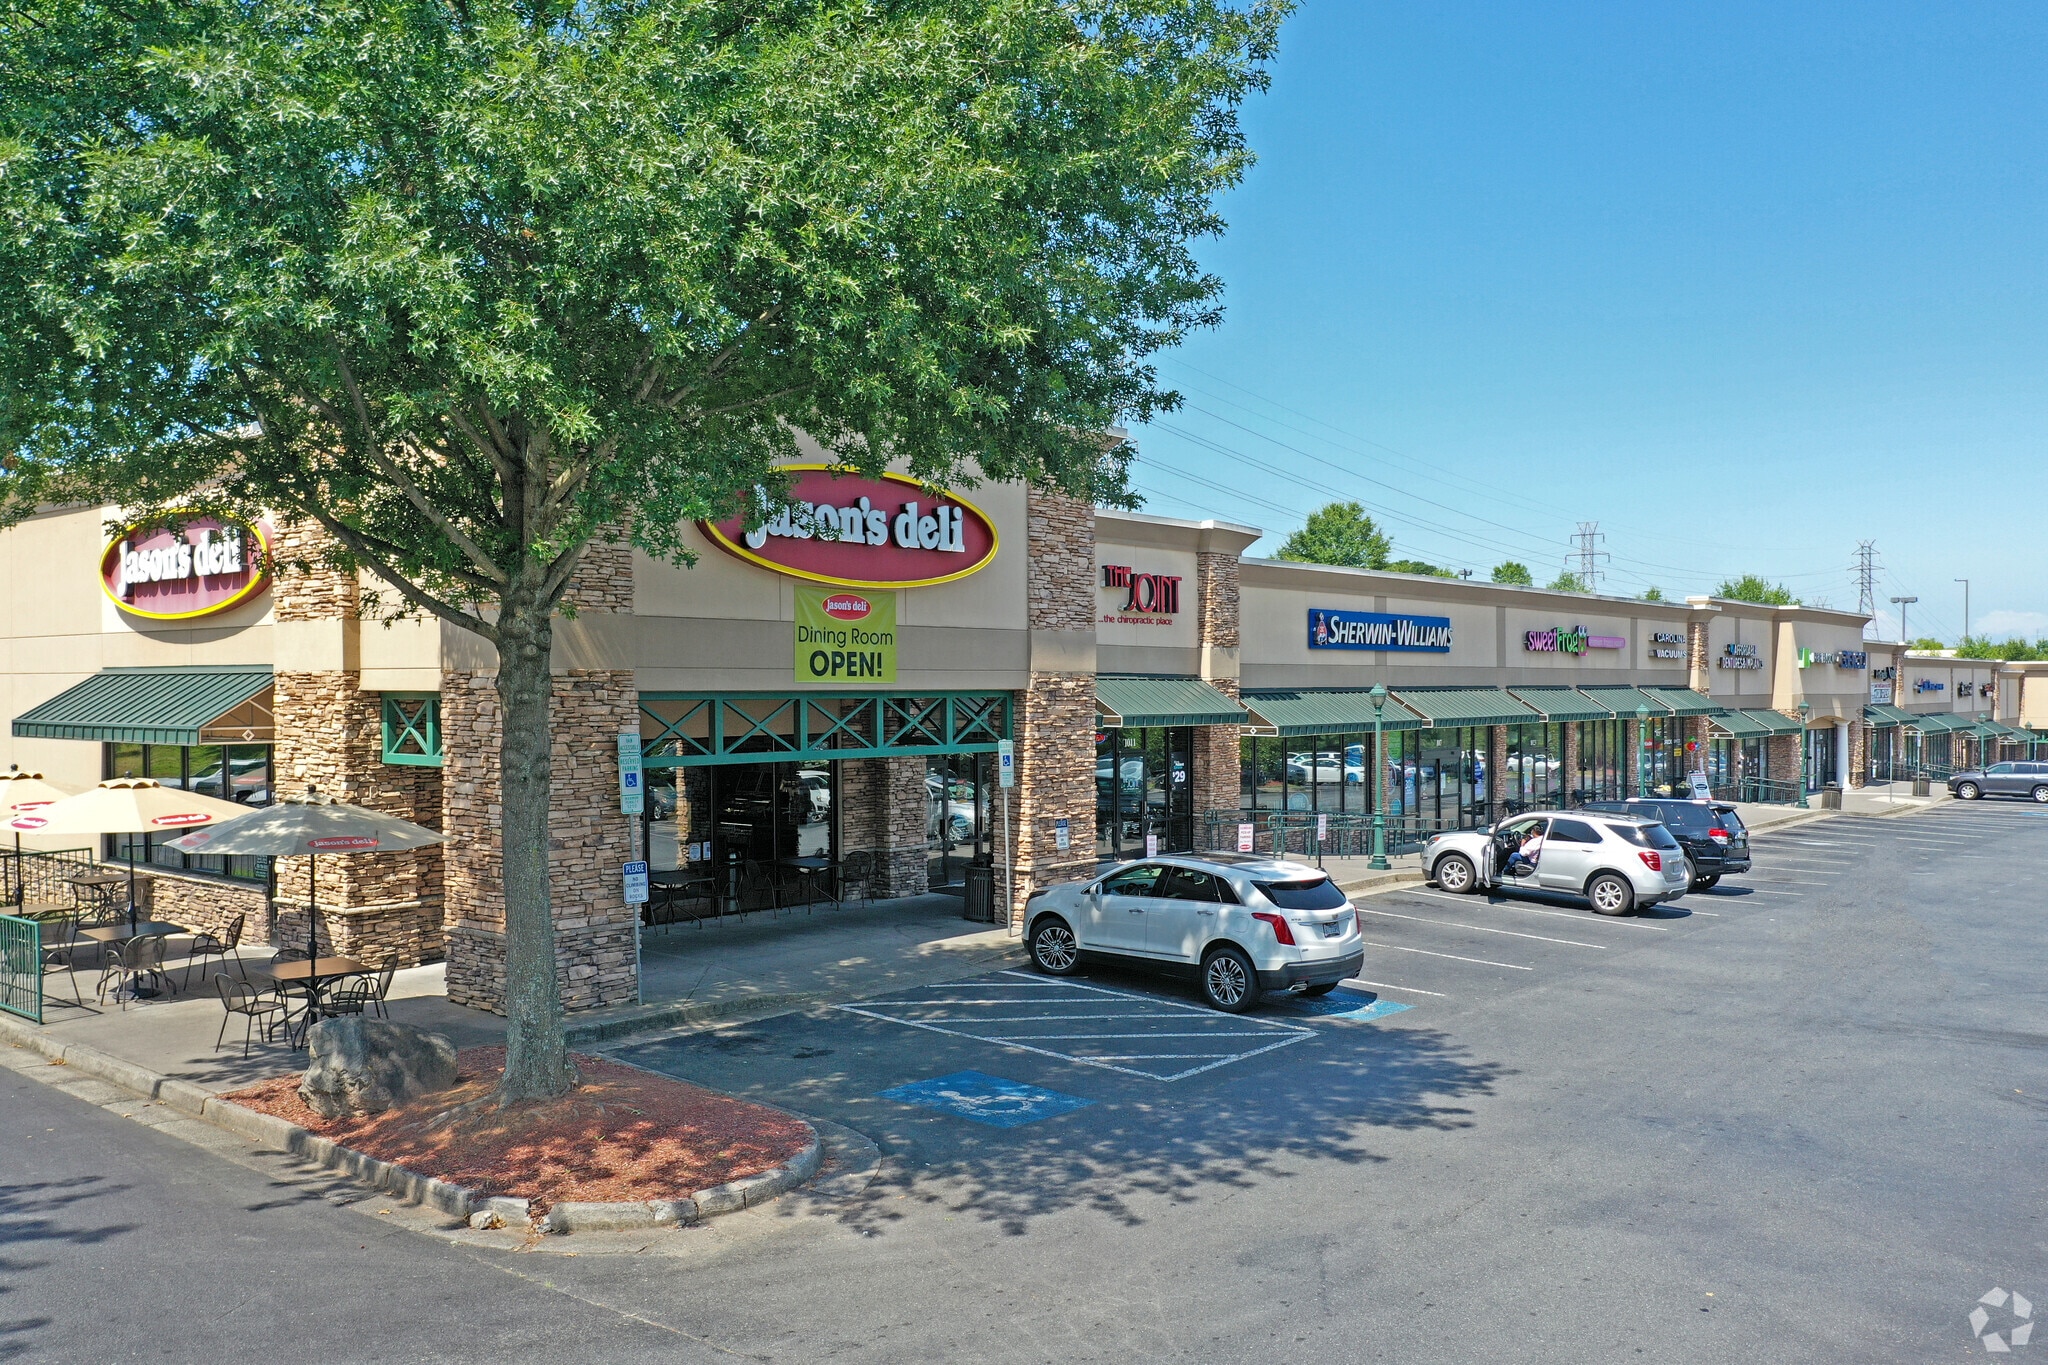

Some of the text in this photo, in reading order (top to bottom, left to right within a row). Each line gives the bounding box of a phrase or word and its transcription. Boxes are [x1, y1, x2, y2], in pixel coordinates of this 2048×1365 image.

[746, 484, 965, 552] Jason's deli
[117, 526, 242, 597] Jason's deli
[1106, 565, 1132, 588] THE
[1128, 573, 1182, 613] JOINT
[826, 599, 867, 612] Jason's deli
[1117, 615, 1154, 625] chiropractic
[1156, 617, 1173, 626] place
[798, 625, 893, 648] Dining Room
[1657, 632, 1686, 643] CAROLINA
[1656, 649, 1687, 659] VACUUMS
[809, 650, 882, 677] OPEN!
[313, 837, 373, 848] Jason's deli
[625, 863, 645, 873] PLEASE
